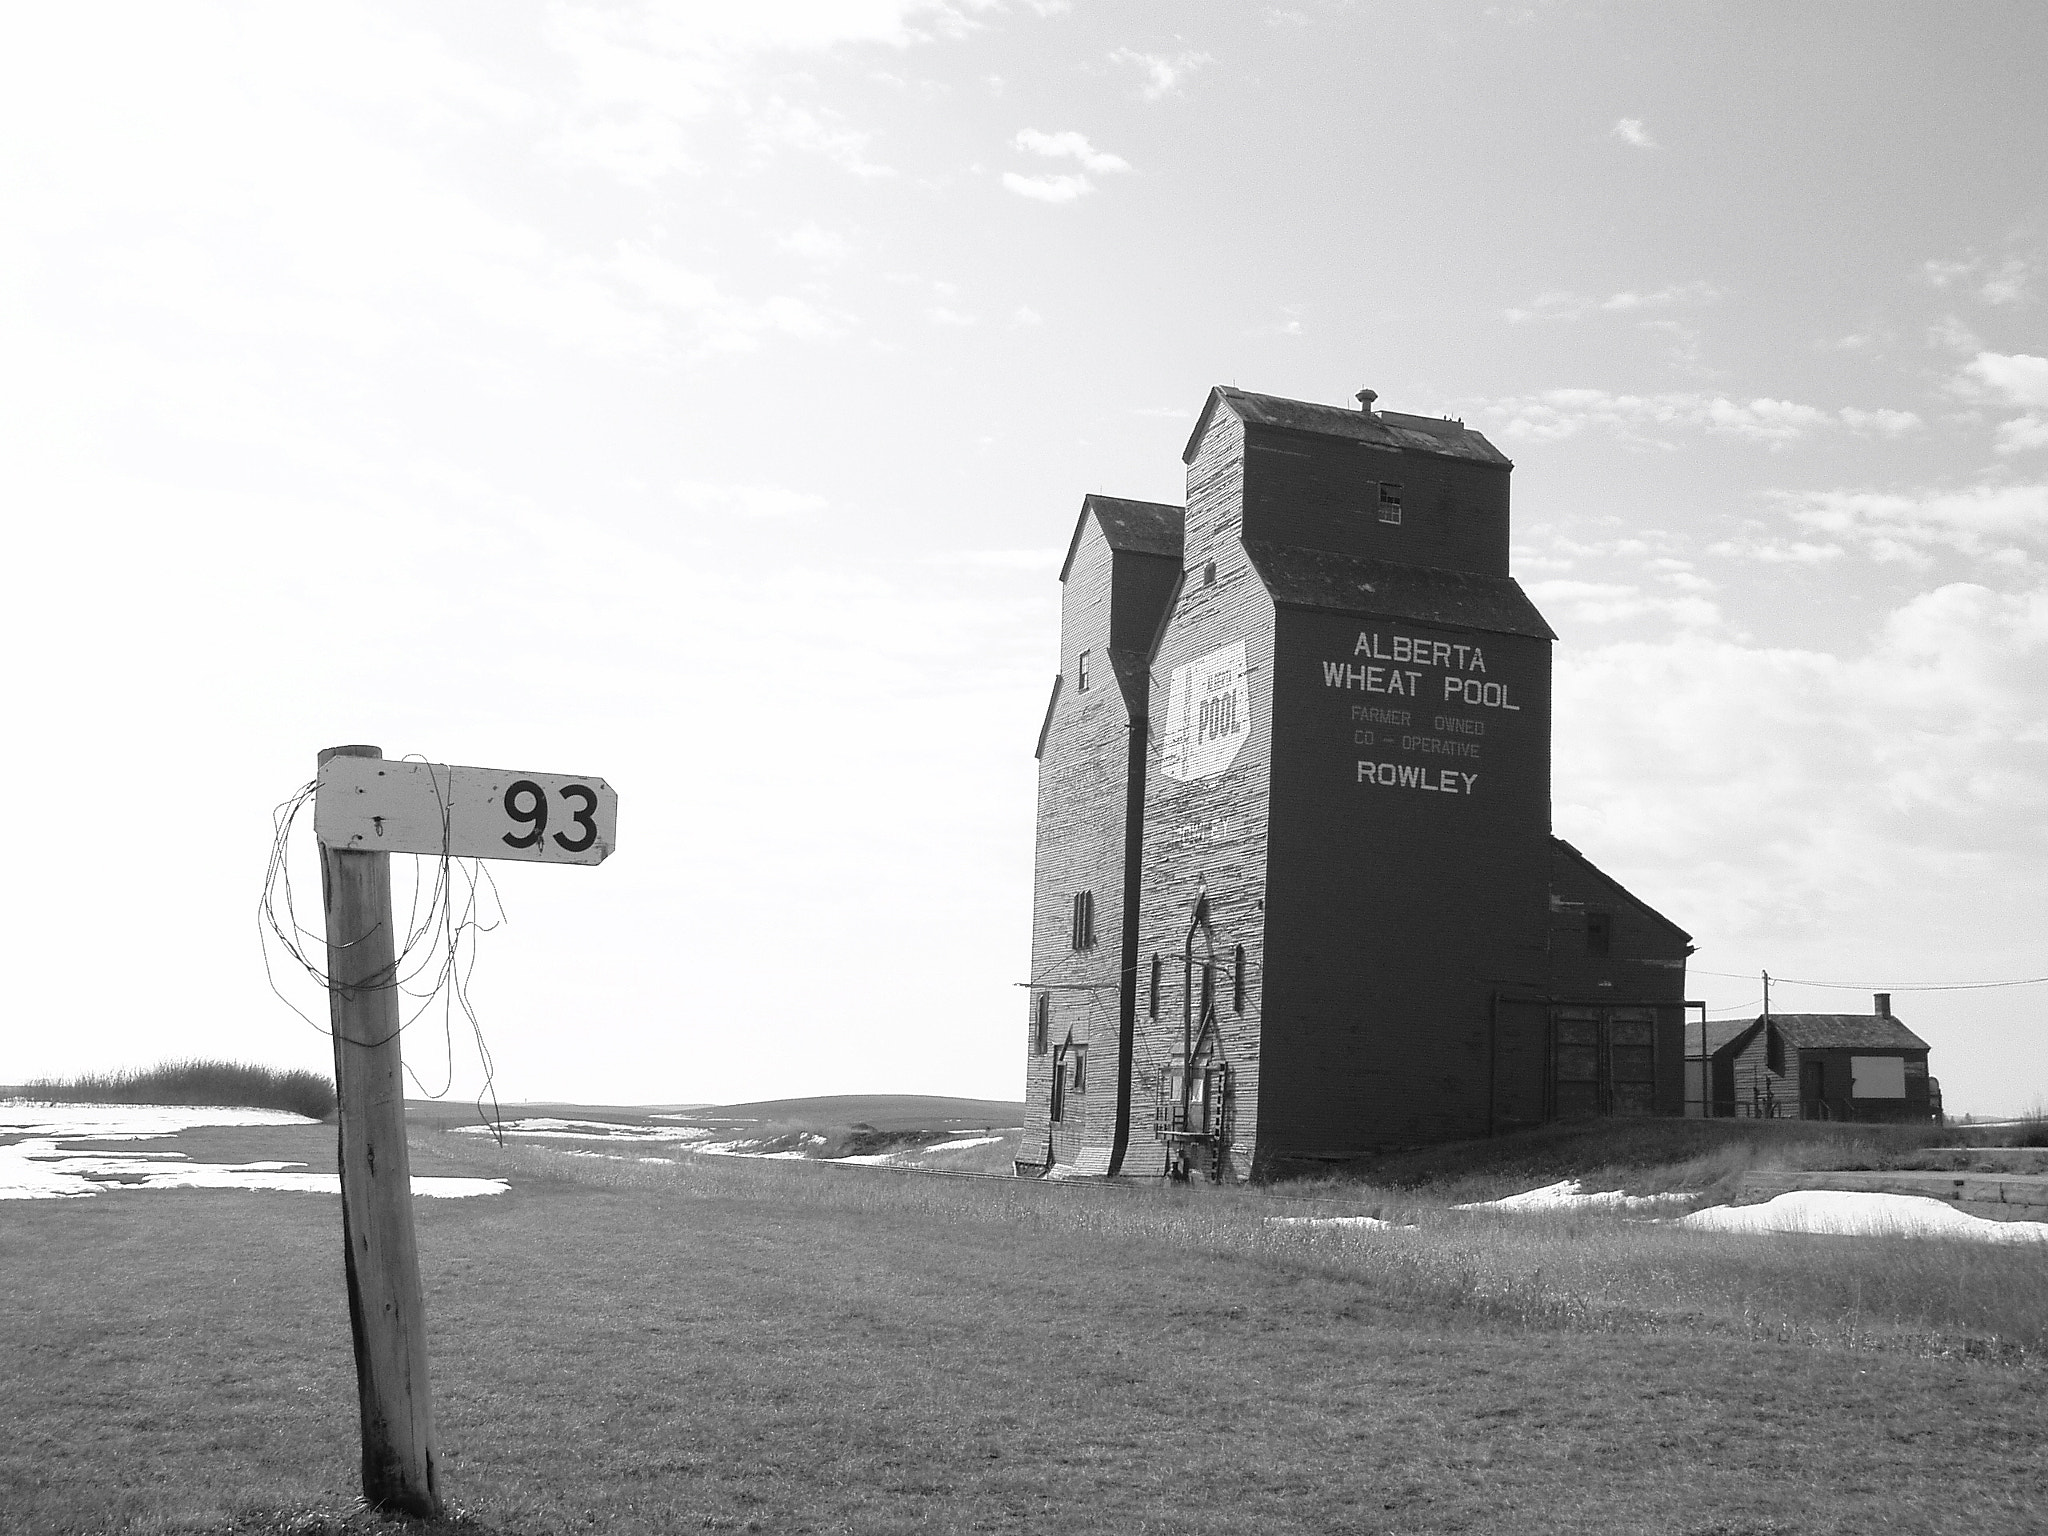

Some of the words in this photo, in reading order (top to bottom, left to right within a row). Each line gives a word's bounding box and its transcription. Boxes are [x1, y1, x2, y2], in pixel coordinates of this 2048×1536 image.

[1354, 632, 1486, 673] ALBERTA
[1323, 661, 1422, 696] WHEAT
[1444, 676, 1520, 711] POOL
[1198, 688, 1241, 745] POOL
[1352, 705, 1411, 726] FARMER
[1435, 715, 1485, 736] OWNED
[1402, 735, 1480, 758] OPERATIVE
[1357, 760, 1478, 794] ROWLEY
[502, 780, 598, 852] 93
